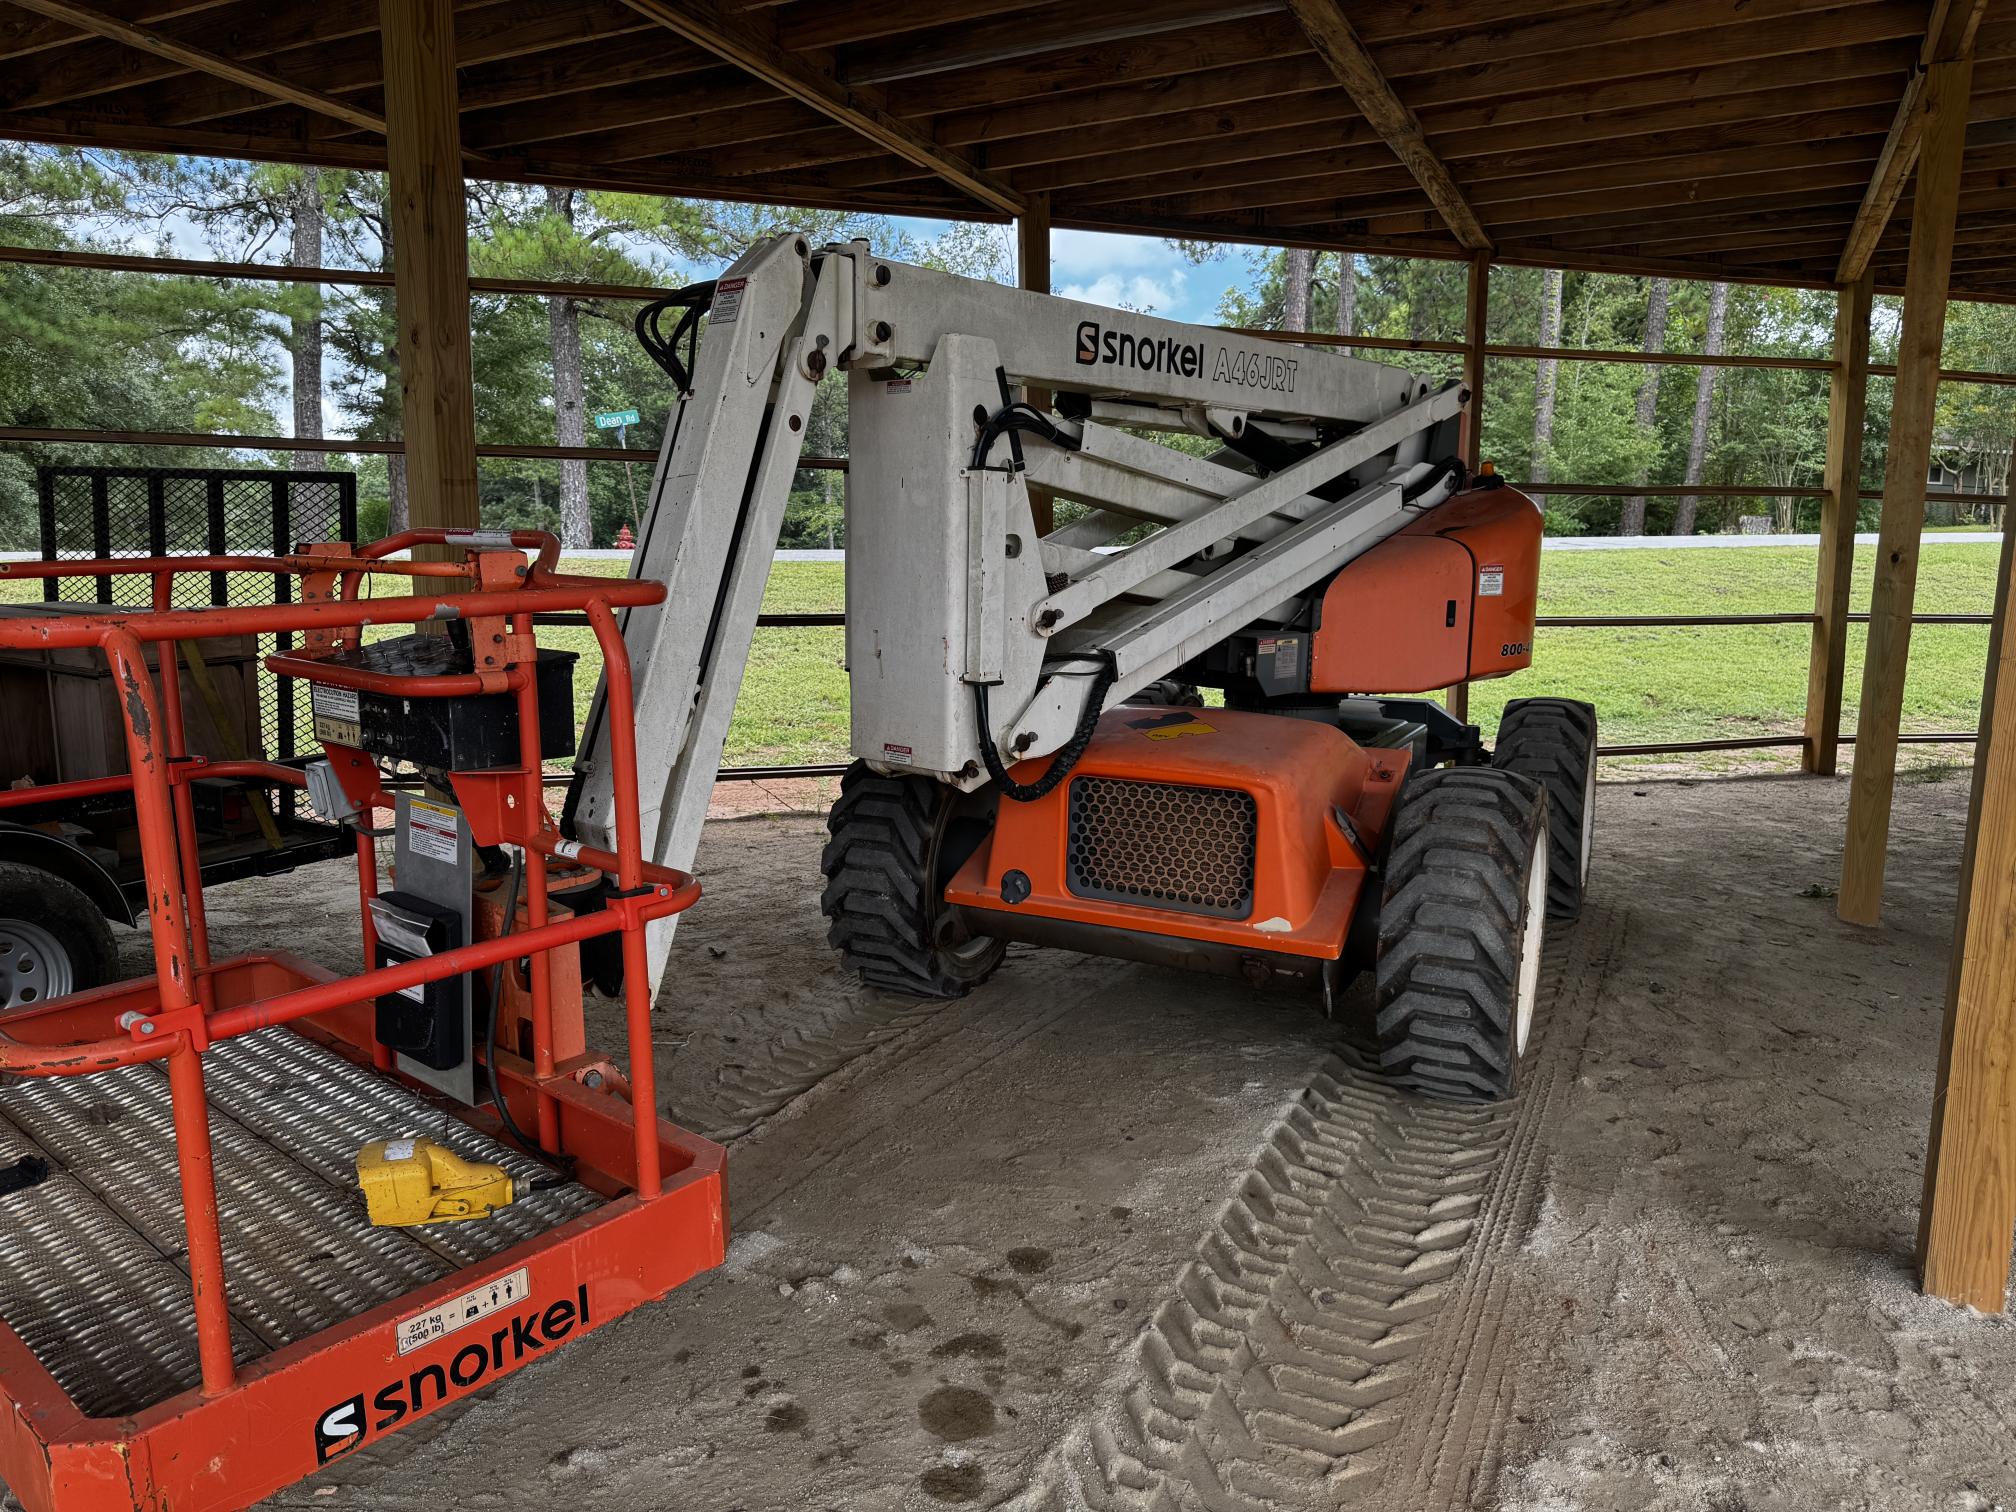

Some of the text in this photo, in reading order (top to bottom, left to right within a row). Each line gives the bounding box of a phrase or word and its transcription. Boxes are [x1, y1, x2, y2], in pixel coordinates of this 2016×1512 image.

[1102, 330, 1205, 379] snorkel
[1212, 347, 1298, 393] A46JRT
[599, 414, 636, 426] Dean Rd
[408, 1322, 444, 1346] (500 lb)
[409, 1314, 442, 1333] 227 kg
[373, 1283, 590, 1432] snorkel
